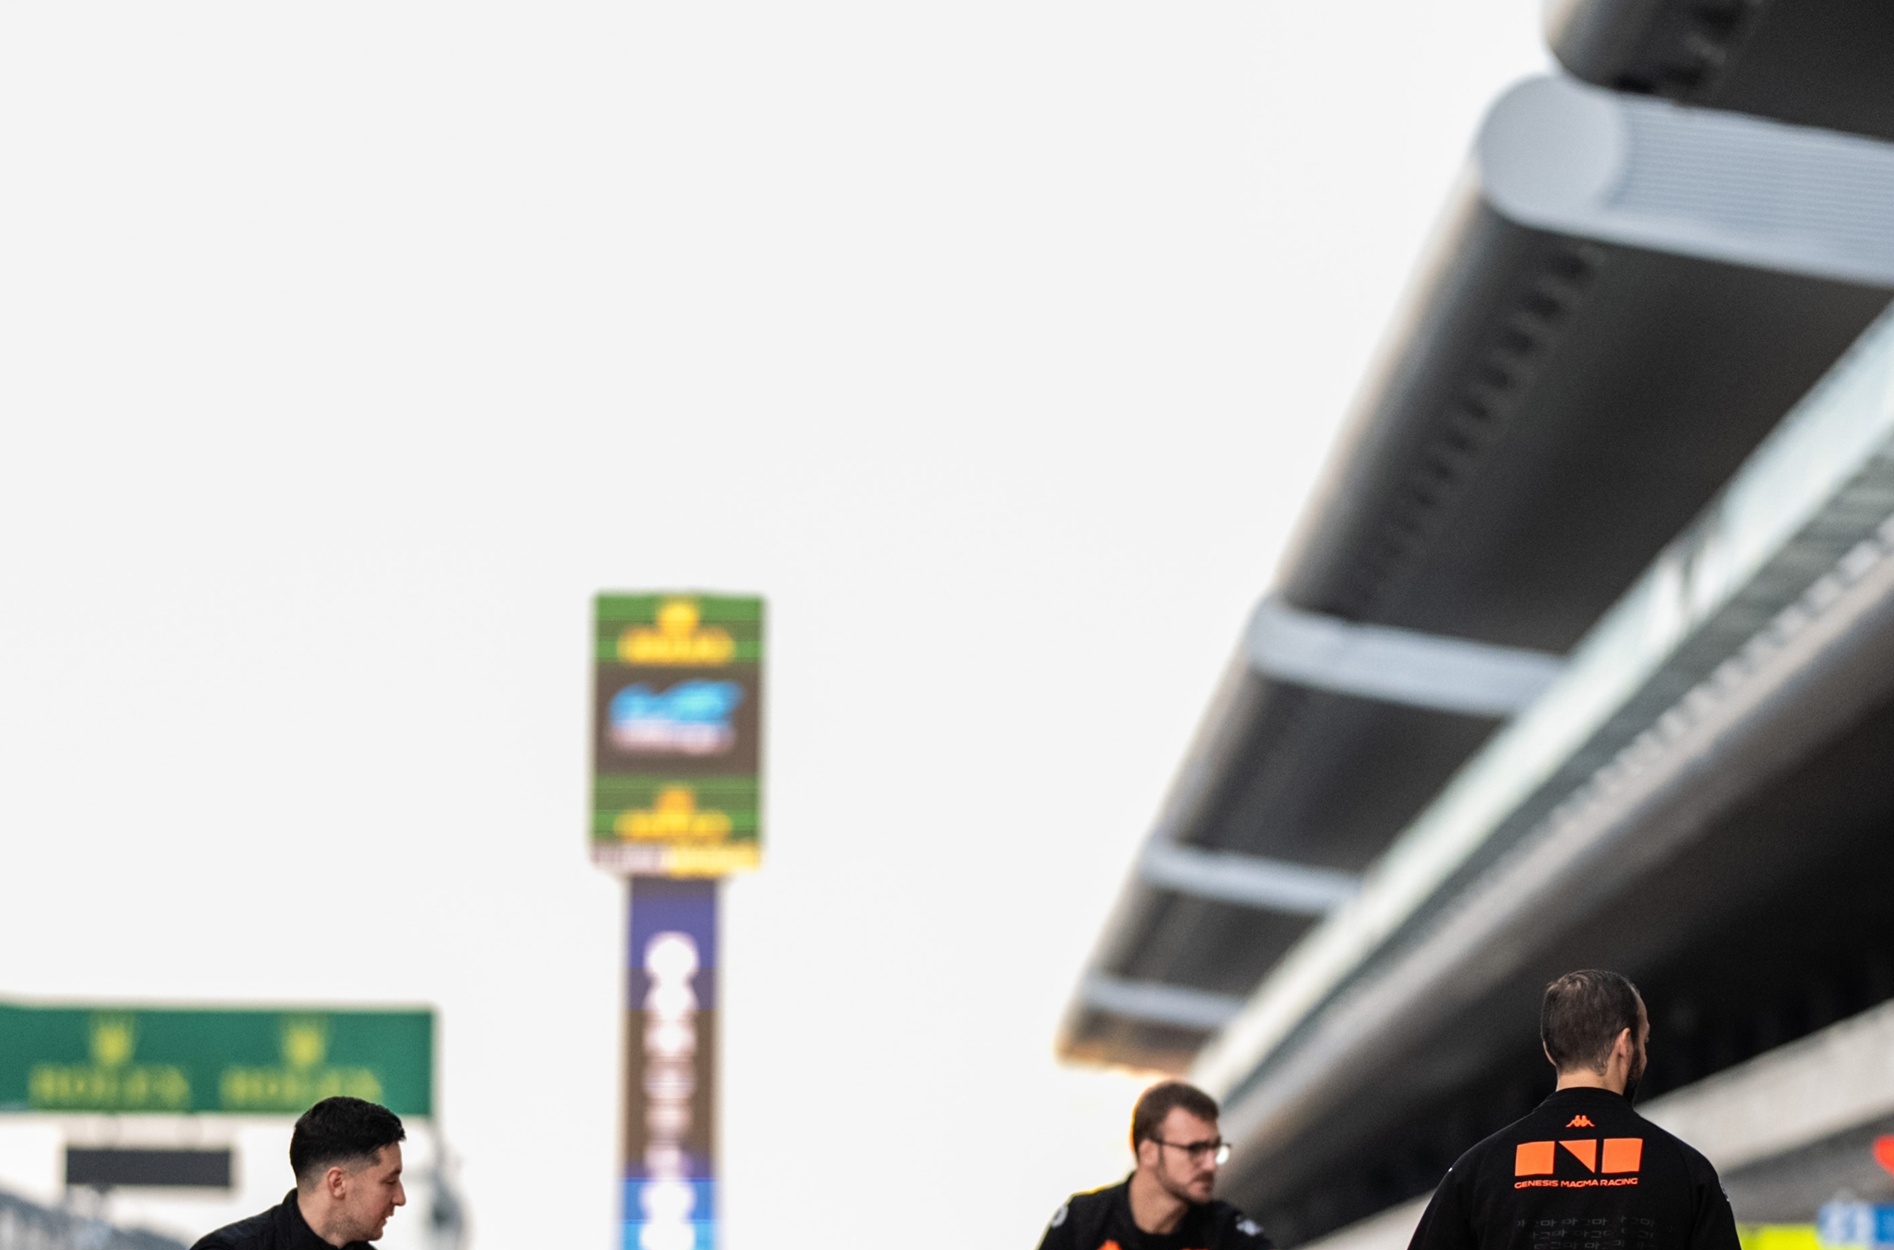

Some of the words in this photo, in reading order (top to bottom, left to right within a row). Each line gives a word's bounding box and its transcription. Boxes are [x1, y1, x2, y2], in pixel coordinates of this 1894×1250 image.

[1514, 1179, 1559, 1189] GENESIS
[1561, 1178, 1599, 1188] MAGMA
[1600, 1177, 1638, 1186] RACING
